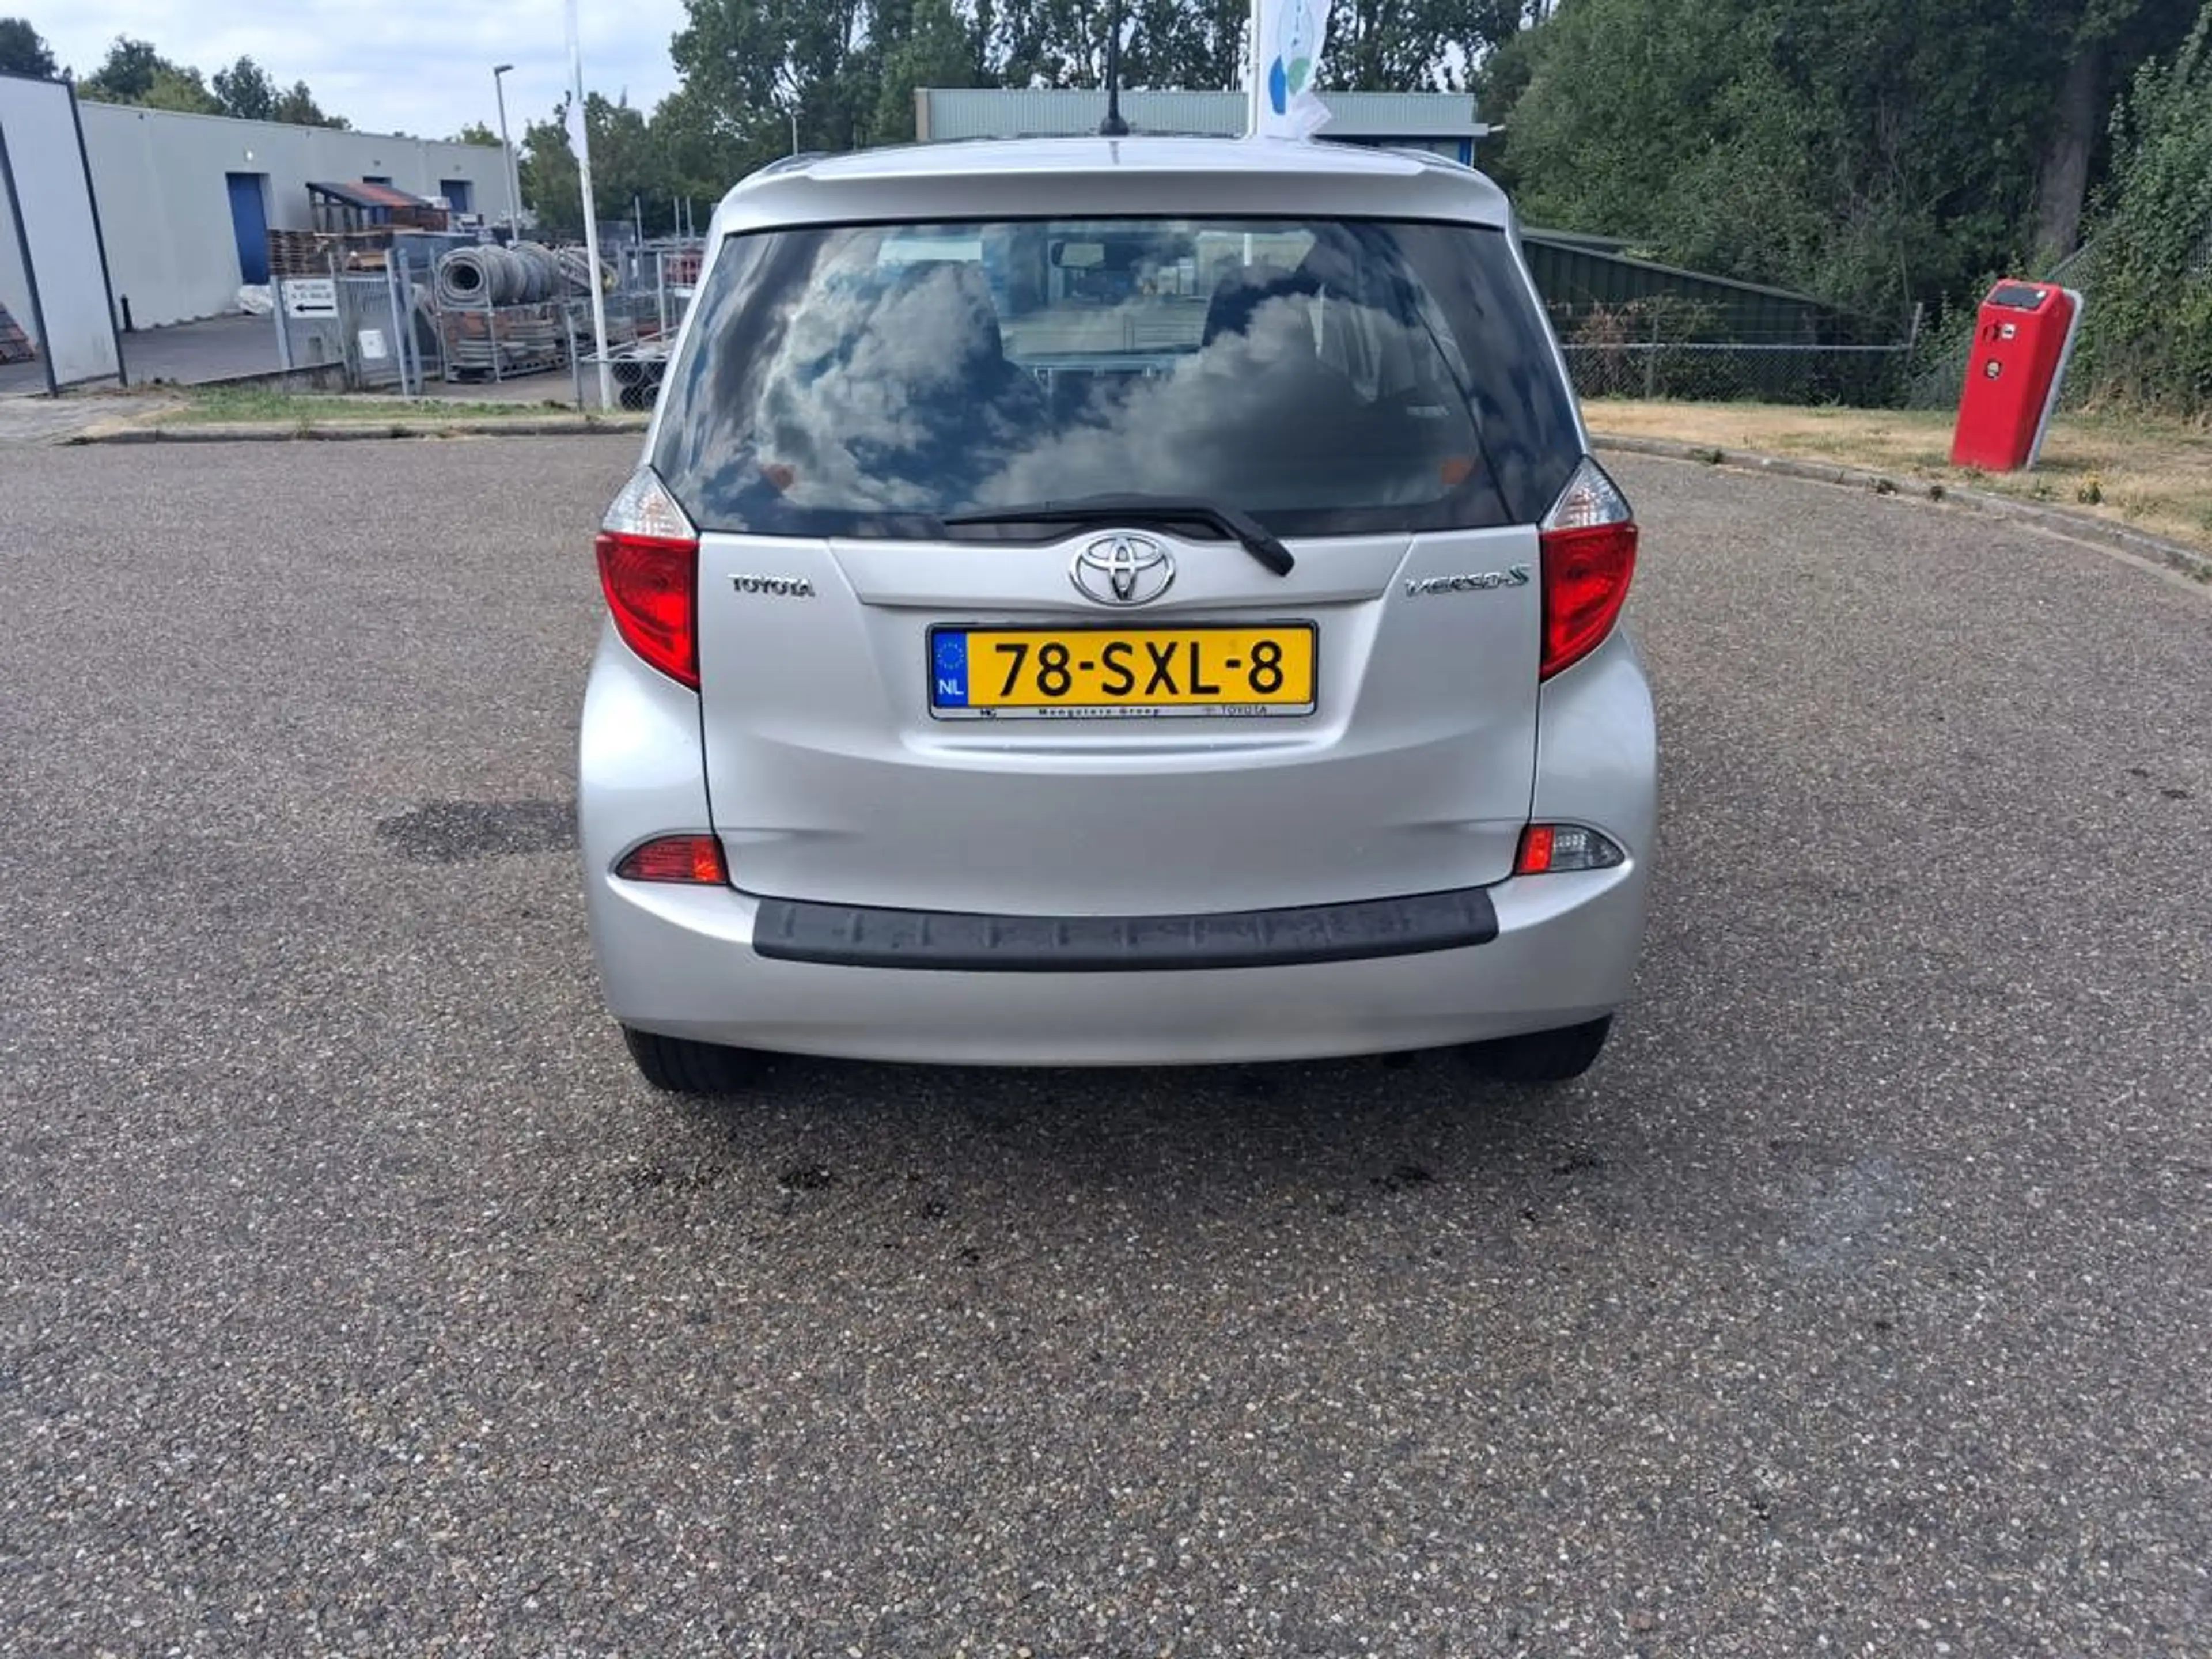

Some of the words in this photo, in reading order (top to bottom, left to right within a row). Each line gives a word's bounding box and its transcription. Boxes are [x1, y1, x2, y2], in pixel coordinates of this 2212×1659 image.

[728, 574, 815, 597] TOYOTA
[995, 641, 1283, 697] 78-SXL-8
[938, 679, 964, 695] NL
[1221, 706, 1267, 715] TOYOTA
